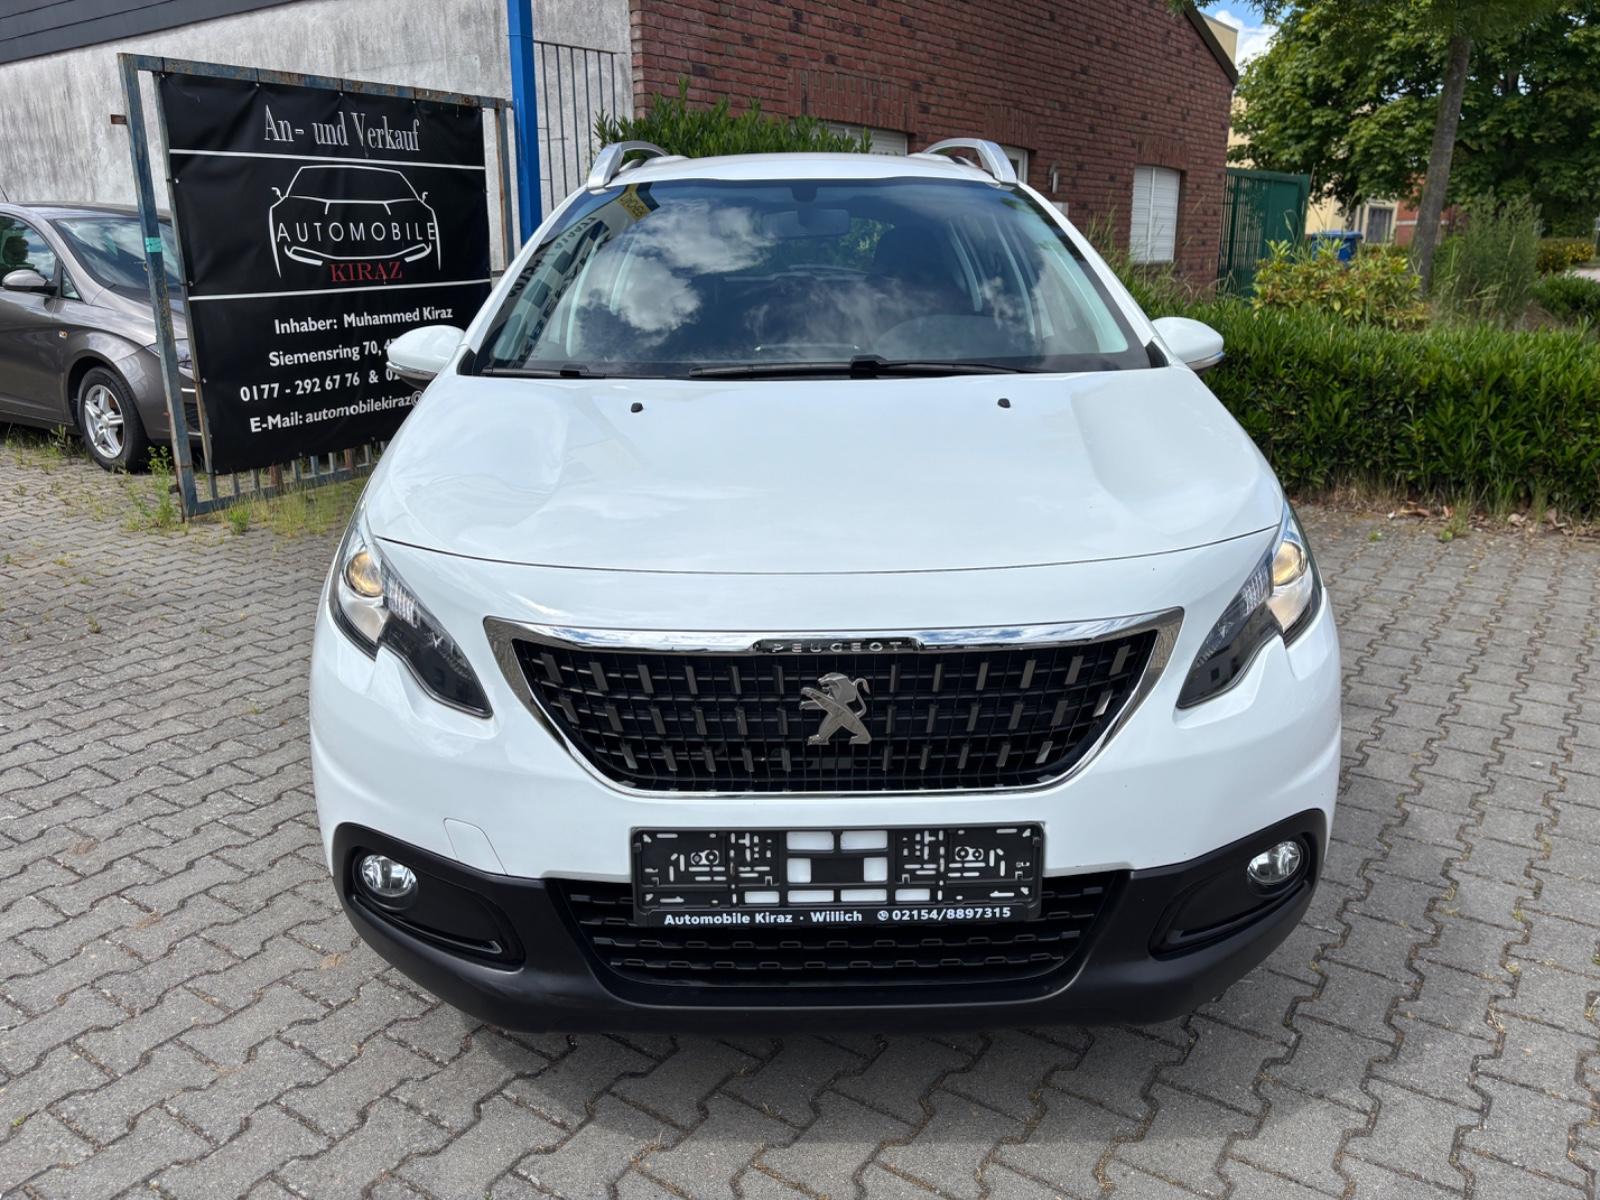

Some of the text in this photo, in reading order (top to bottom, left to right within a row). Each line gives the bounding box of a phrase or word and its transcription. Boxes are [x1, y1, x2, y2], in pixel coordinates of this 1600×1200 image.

[264, 104, 421, 151] An- und Verkauf
[277, 222, 436, 242] AUTOMOBILE
[329, 261, 403, 283] KIRAZ
[274, 306, 453, 335] Inhaber: Muhammed Kiraz
[269, 344, 360, 367] Siemensring
[362, 340, 382, 356] 70,
[240, 383, 280, 402] 0177
[295, 378, 321, 396] 292
[325, 375, 341, 391] 67
[345, 371, 360, 387] 76
[249, 412, 304, 433] E-Mail:
[772, 641, 902, 653] PEUGEOT
[664, 912, 750, 925] Automobile
[755, 912, 793, 924] Kiraz
[810, 910, 863, 923] Willich
[892, 907, 1011, 921] 02154/8897315
